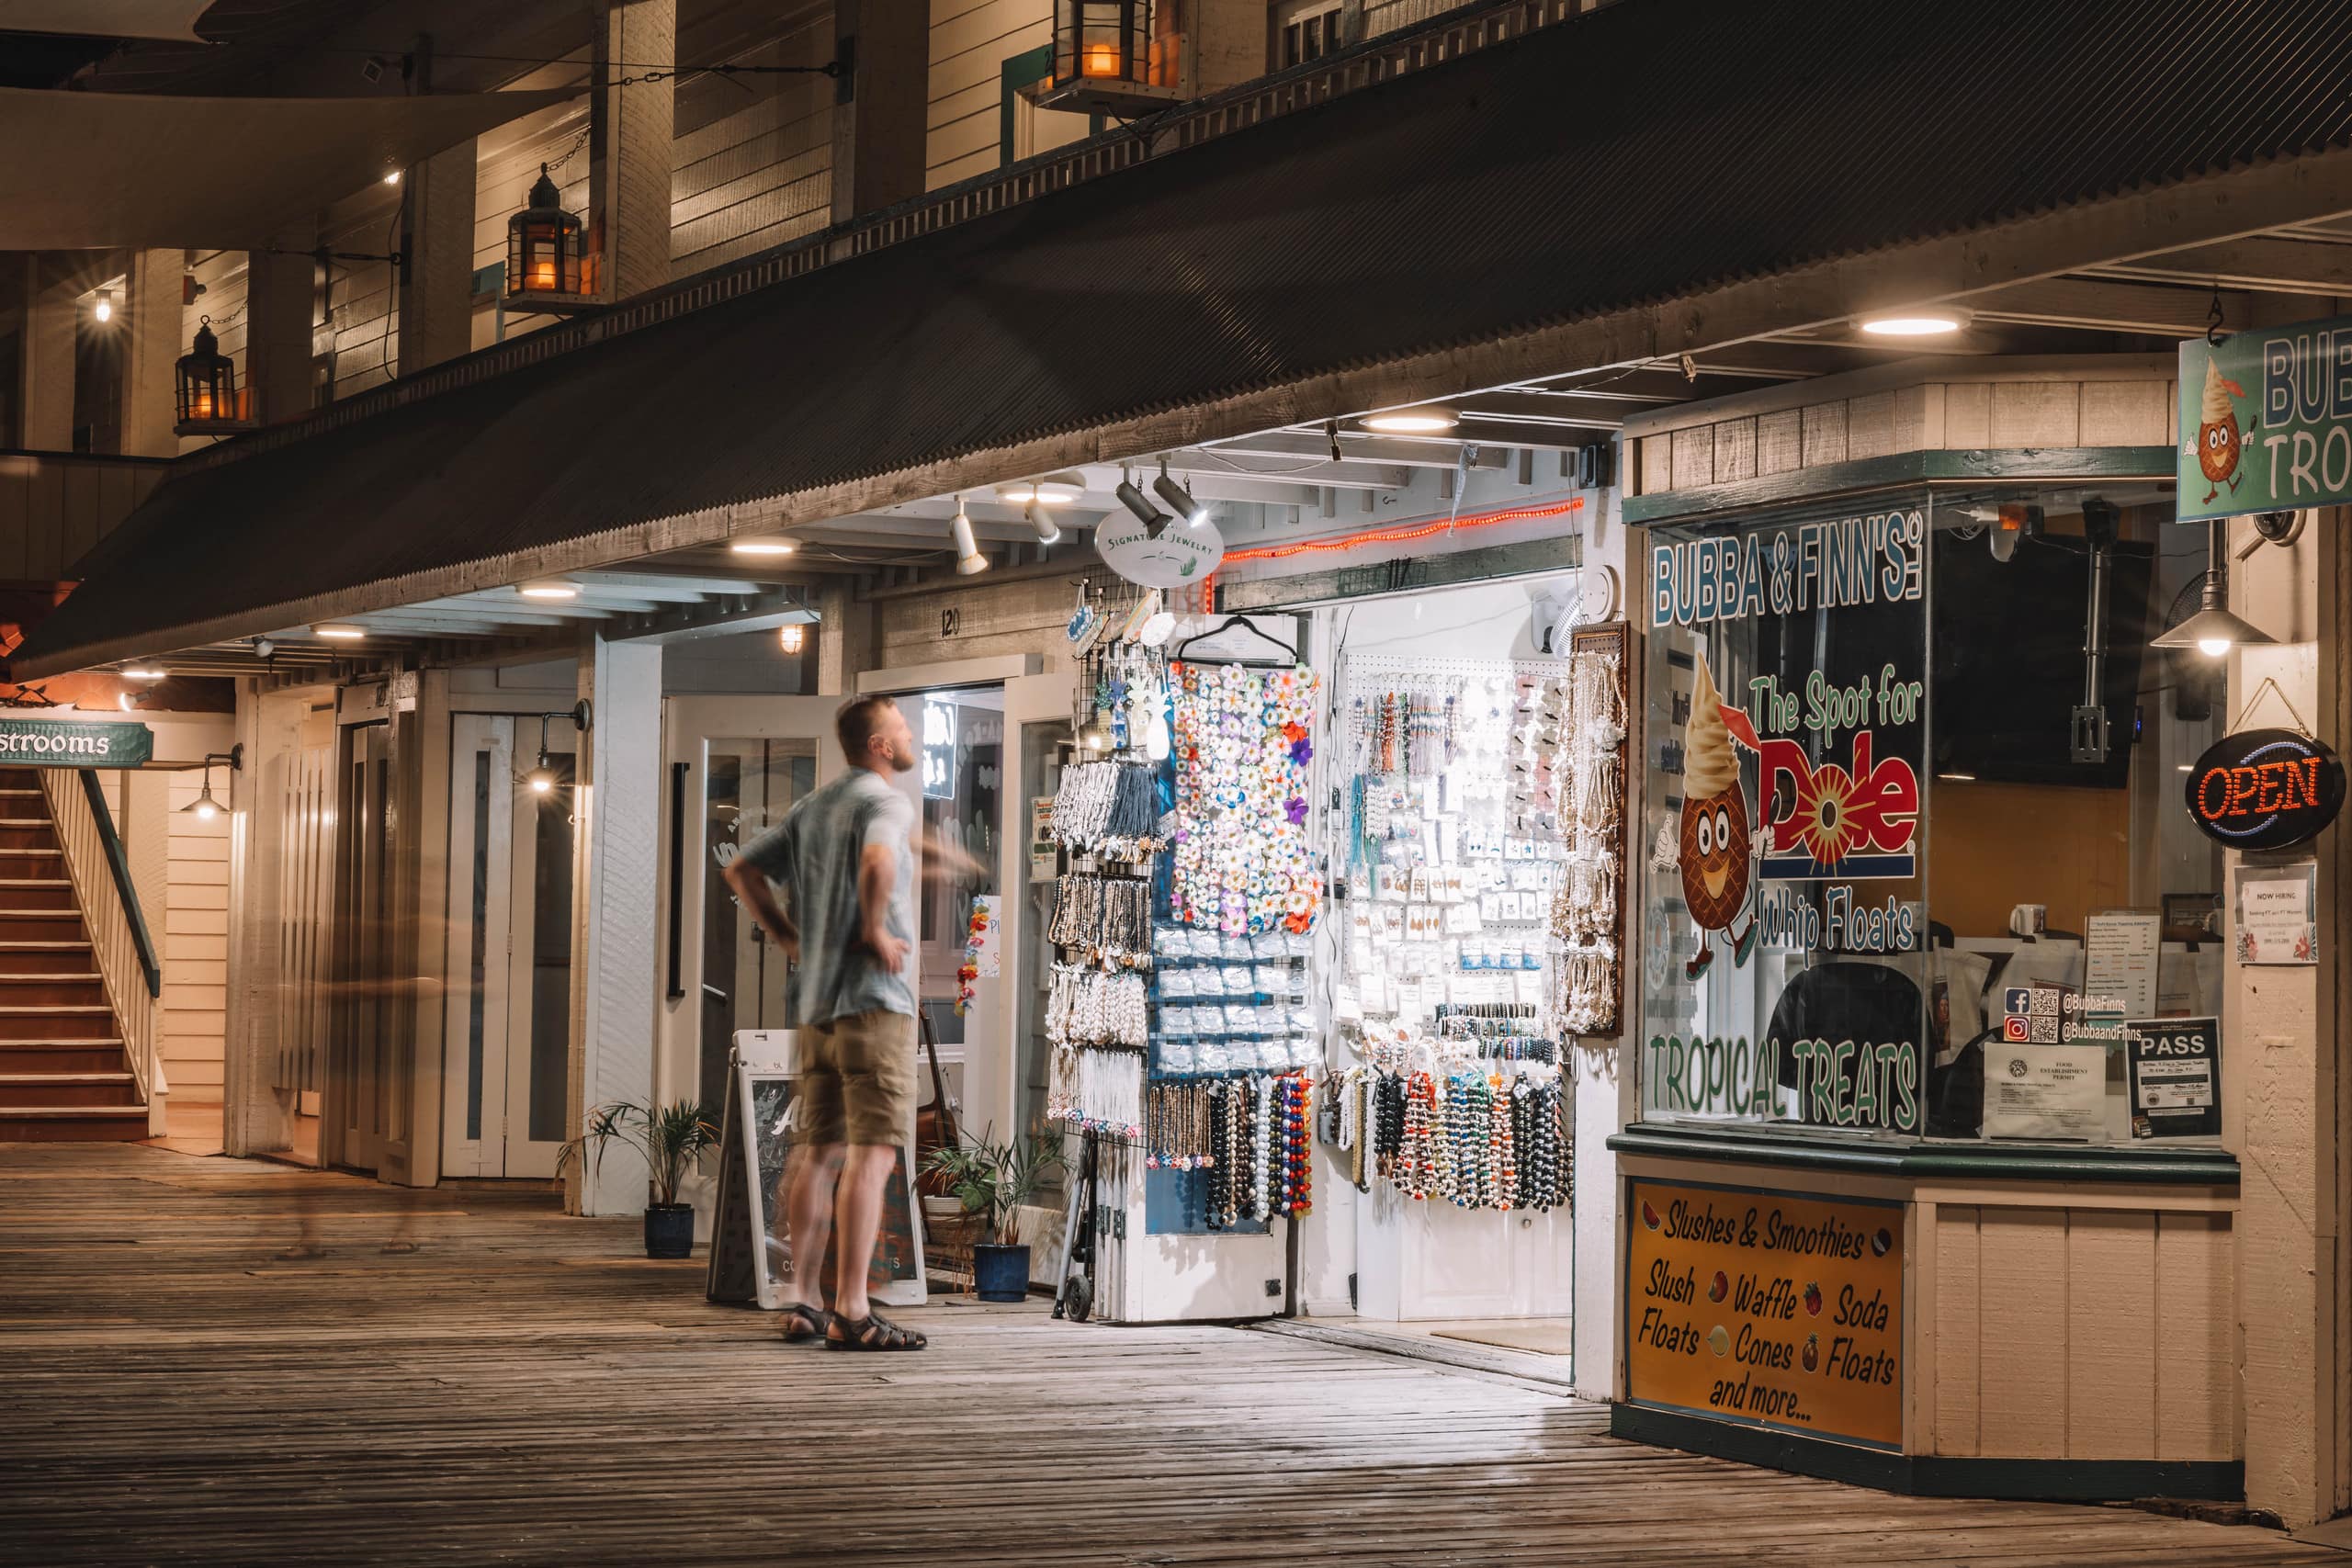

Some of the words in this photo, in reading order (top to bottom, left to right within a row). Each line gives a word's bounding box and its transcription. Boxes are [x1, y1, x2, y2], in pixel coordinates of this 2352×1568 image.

[2263, 425, 2352, 500] TRO
[1108, 534, 1165, 551] SIGNATE
[1653, 532, 1765, 627] BUBBA
[1771, 531, 1792, 615] &
[1798, 512, 1907, 612] FINN'S
[942, 607, 960, 638] 120
[1749, 674, 1799, 734] The
[1804, 670, 1871, 749] Spot
[1878, 663, 1923, 726] for
[1758, 730, 1919, 864] Dole
[2198, 757, 2323, 820] OPEN
[1758, 886, 1820, 971] Whip
[1826, 885, 1914, 952] Floats
[2062, 1021, 2142, 1042] @BubbaandFinns
[2063, 993, 2126, 1013] @BubbaFinns
[2140, 1035, 2205, 1055] PASS
[1650, 1033, 1787, 1116] TROPICAL
[1792, 1039, 1917, 1130] TREATS
[1664, 1199, 1736, 1245] Slushes
[1739, 1207, 1758, 1248] &
[1763, 1209, 1865, 1260] Smoothies
[1645, 1258, 1695, 1305] Slush
[1734, 1274, 1797, 1320] Waffle
[1834, 1284, 1889, 1332] Soda
[1638, 1306, 1700, 1356] Floats
[1735, 1323, 1794, 1371] Cones
[1826, 1337, 1895, 1385] Floats
[1709, 1371, 1750, 1410] and
[1749, 1385, 1811, 1422] more...
